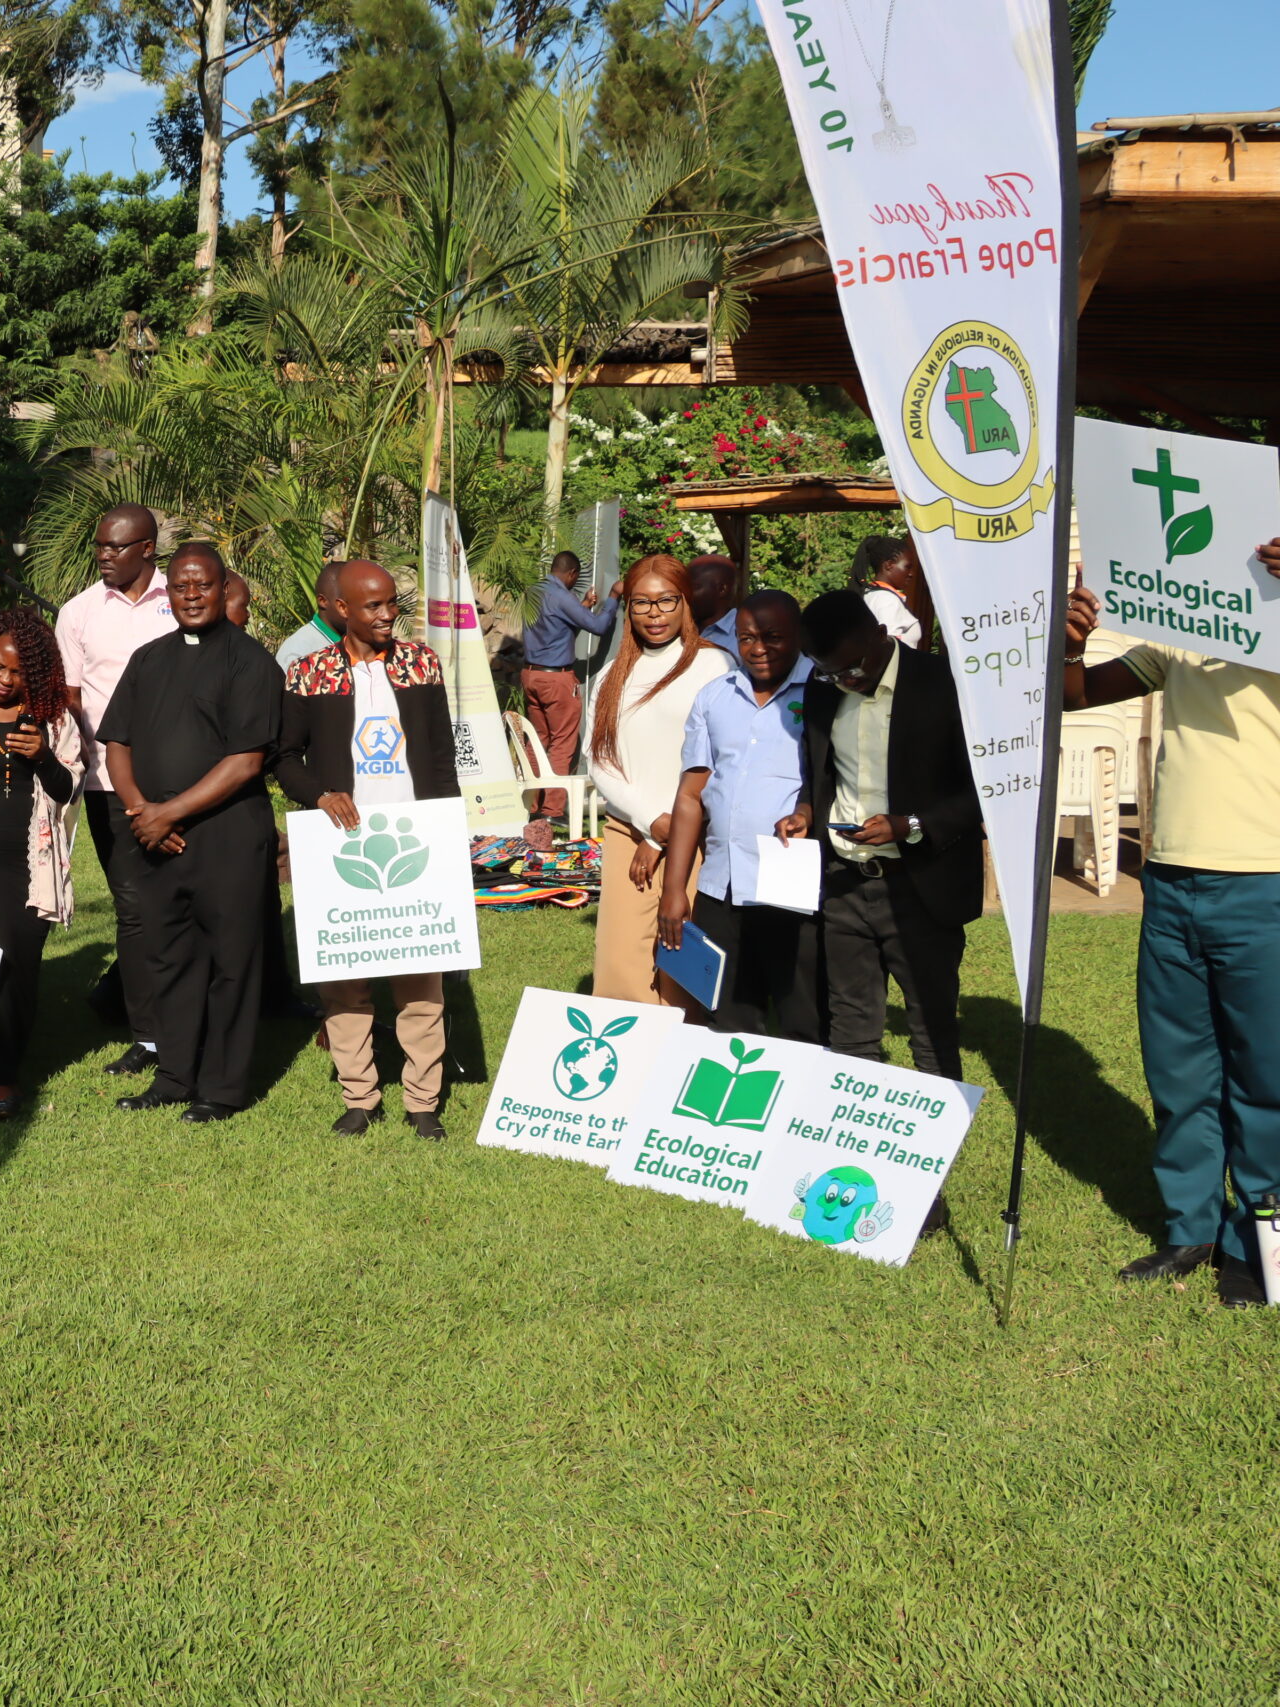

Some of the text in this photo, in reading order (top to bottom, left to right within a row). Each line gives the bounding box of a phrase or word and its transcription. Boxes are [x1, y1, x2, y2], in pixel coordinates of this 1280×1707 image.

[1109, 559, 1252, 614] Ecological
[1104, 589, 1261, 655] Spirituality
[356, 761, 405, 774] KGDL
[327, 899, 442, 924] Community
[317, 916, 456, 945] Resilience and
[316, 939, 461, 968] Empowerment
[830, 1072, 946, 1119] Stop using
[495, 1116, 525, 1138] Cry
[530, 1124, 551, 1138] of
[553, 1127, 581, 1145] the
[500, 1097, 628, 1132] Response to th
[831, 1103, 916, 1137] plastics
[644, 1128, 762, 1171] Ecological
[787, 1117, 945, 1174] Heal the Planet
[634, 1152, 748, 1195] Education
